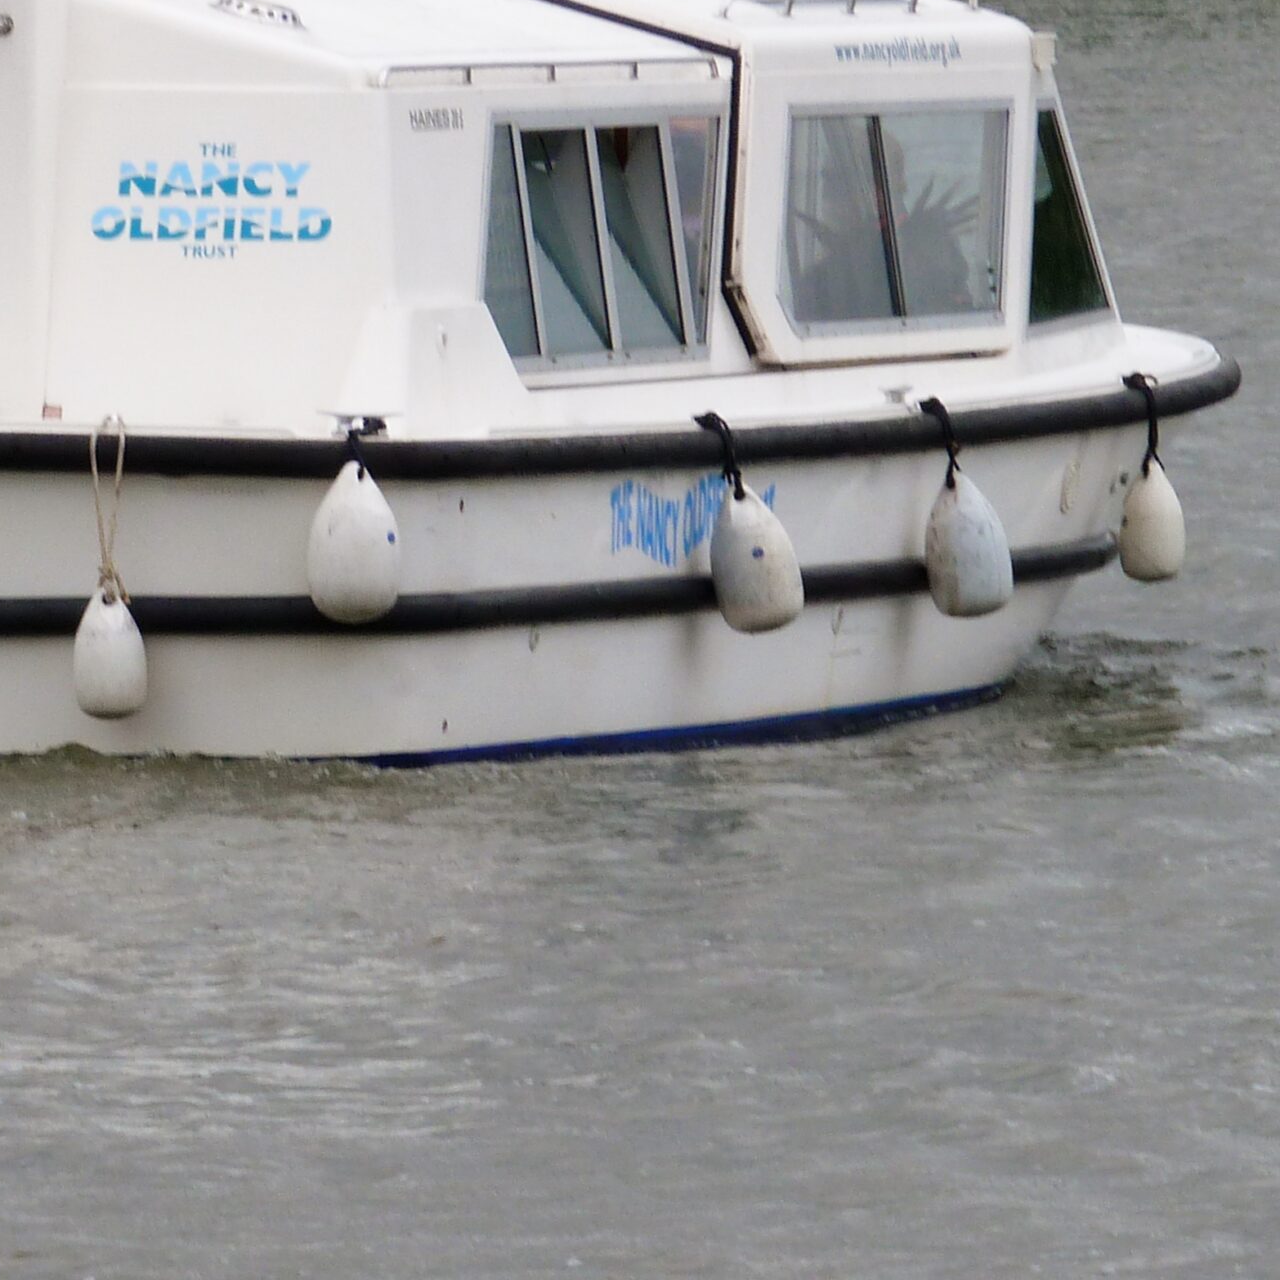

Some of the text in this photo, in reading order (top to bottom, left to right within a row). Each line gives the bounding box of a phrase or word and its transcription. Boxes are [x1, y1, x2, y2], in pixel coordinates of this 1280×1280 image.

[834, 35, 962, 68] www.nancyoldfield.org.uk
[200, 142, 237, 158] THE
[118, 160, 311, 198] NANCY
[90, 206, 333, 241] OLDFIELD
[182, 245, 238, 259] TRUST
[610, 479, 634, 555] THE
[635, 482, 679, 568] NANCY
